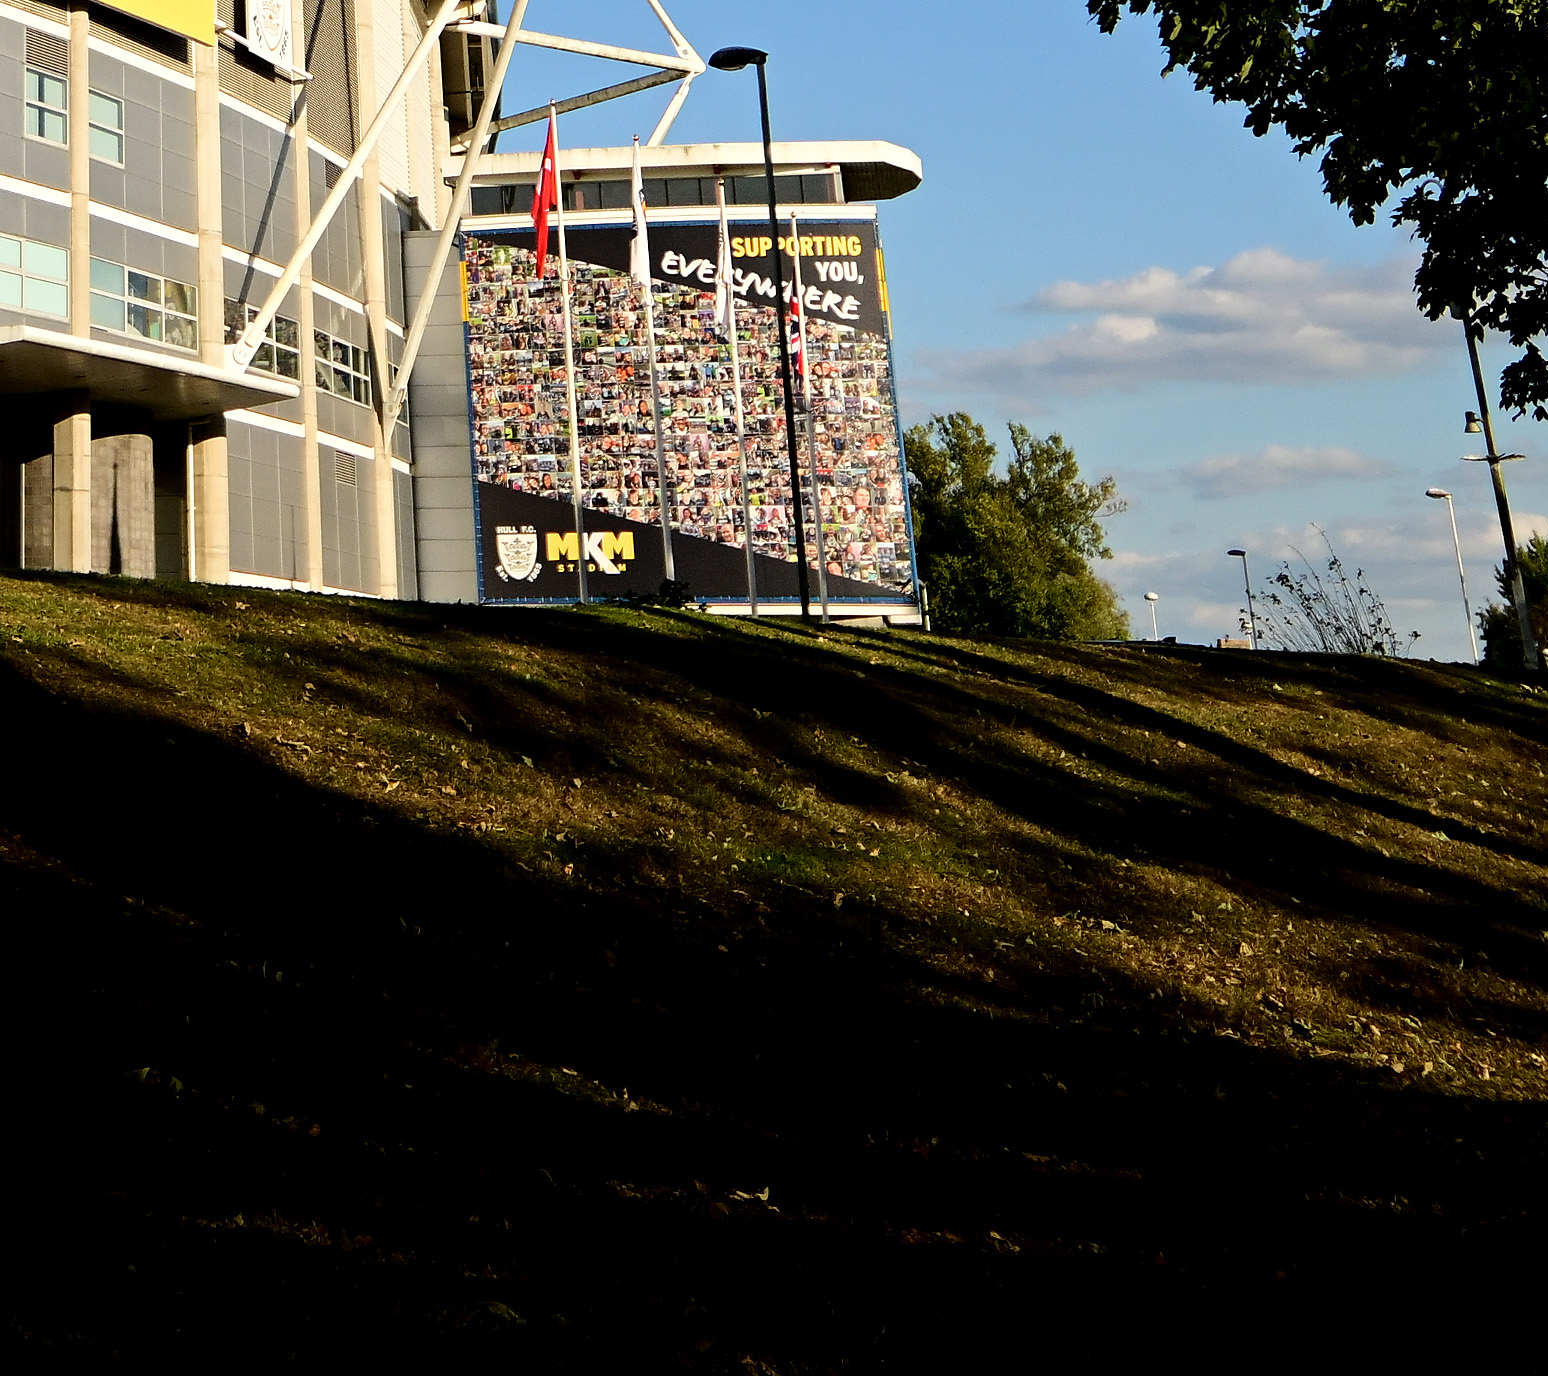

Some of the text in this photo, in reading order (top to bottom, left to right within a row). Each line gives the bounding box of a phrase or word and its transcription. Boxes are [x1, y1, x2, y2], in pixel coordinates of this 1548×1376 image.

[661, 250, 862, 320] EVEYWERE
[814, 261, 864, 285] YOU,
[546, 531, 635, 574] MKM
[557, 563, 627, 574] STDM
